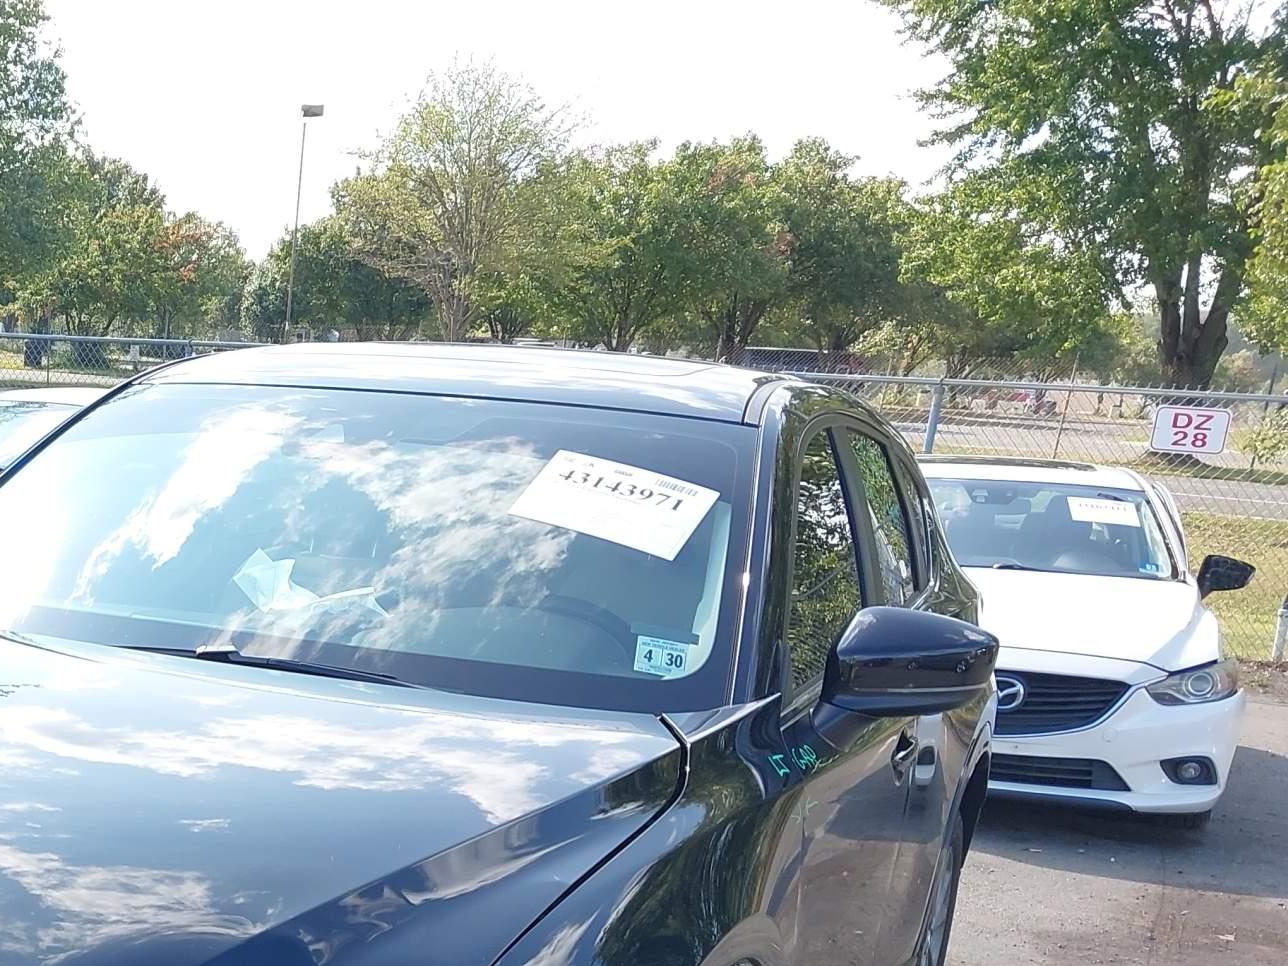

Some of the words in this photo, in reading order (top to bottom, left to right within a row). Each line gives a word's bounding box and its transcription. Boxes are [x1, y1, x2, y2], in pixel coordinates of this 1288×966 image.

[1172, 413, 1215, 431] DZ
[1171, 431, 1207, 448] 28
[560, 469, 684, 511] 43143971
[644, 649, 654, 663] 4
[665, 653, 684, 668] 30
